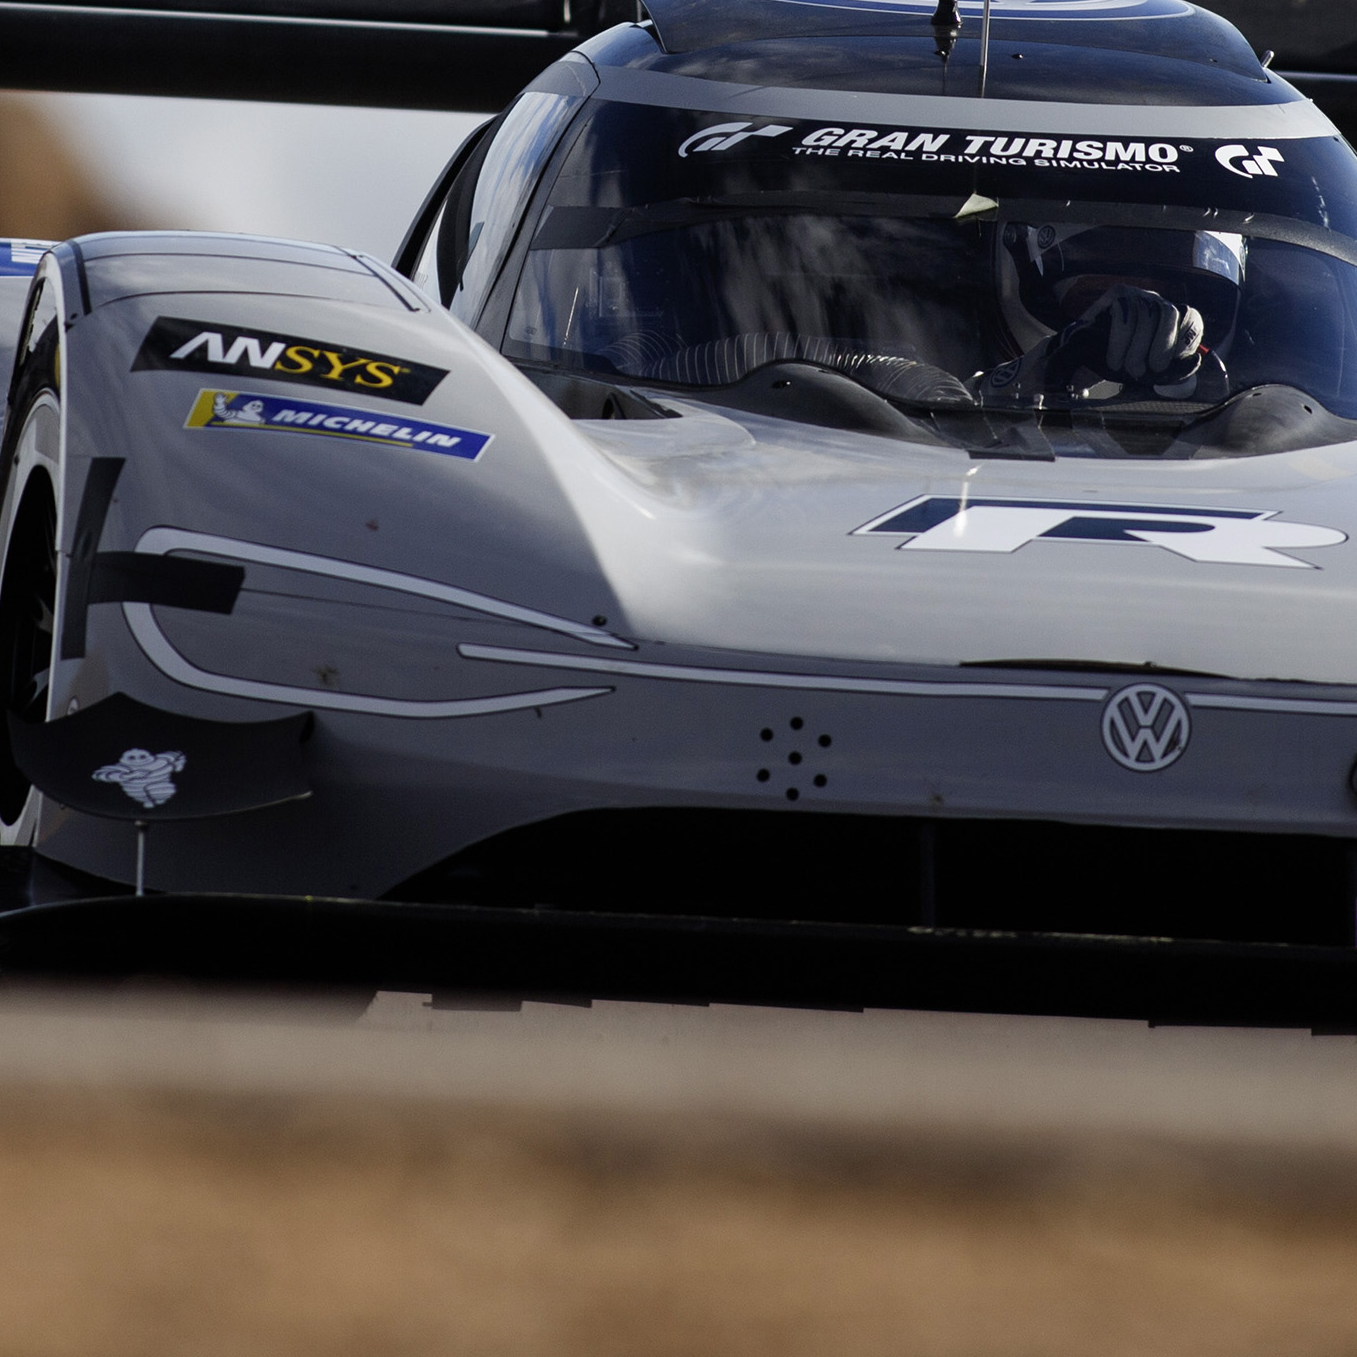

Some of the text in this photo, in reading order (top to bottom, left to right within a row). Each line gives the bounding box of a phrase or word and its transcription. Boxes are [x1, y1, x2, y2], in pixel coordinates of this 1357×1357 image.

[802, 128, 950, 152] GRAN
[793, 147, 1180, 172] THE REAL DRIVING SIMULATOR
[271, 409, 462, 448] MICHELIN
[1101, 682, 1190, 772] VW
